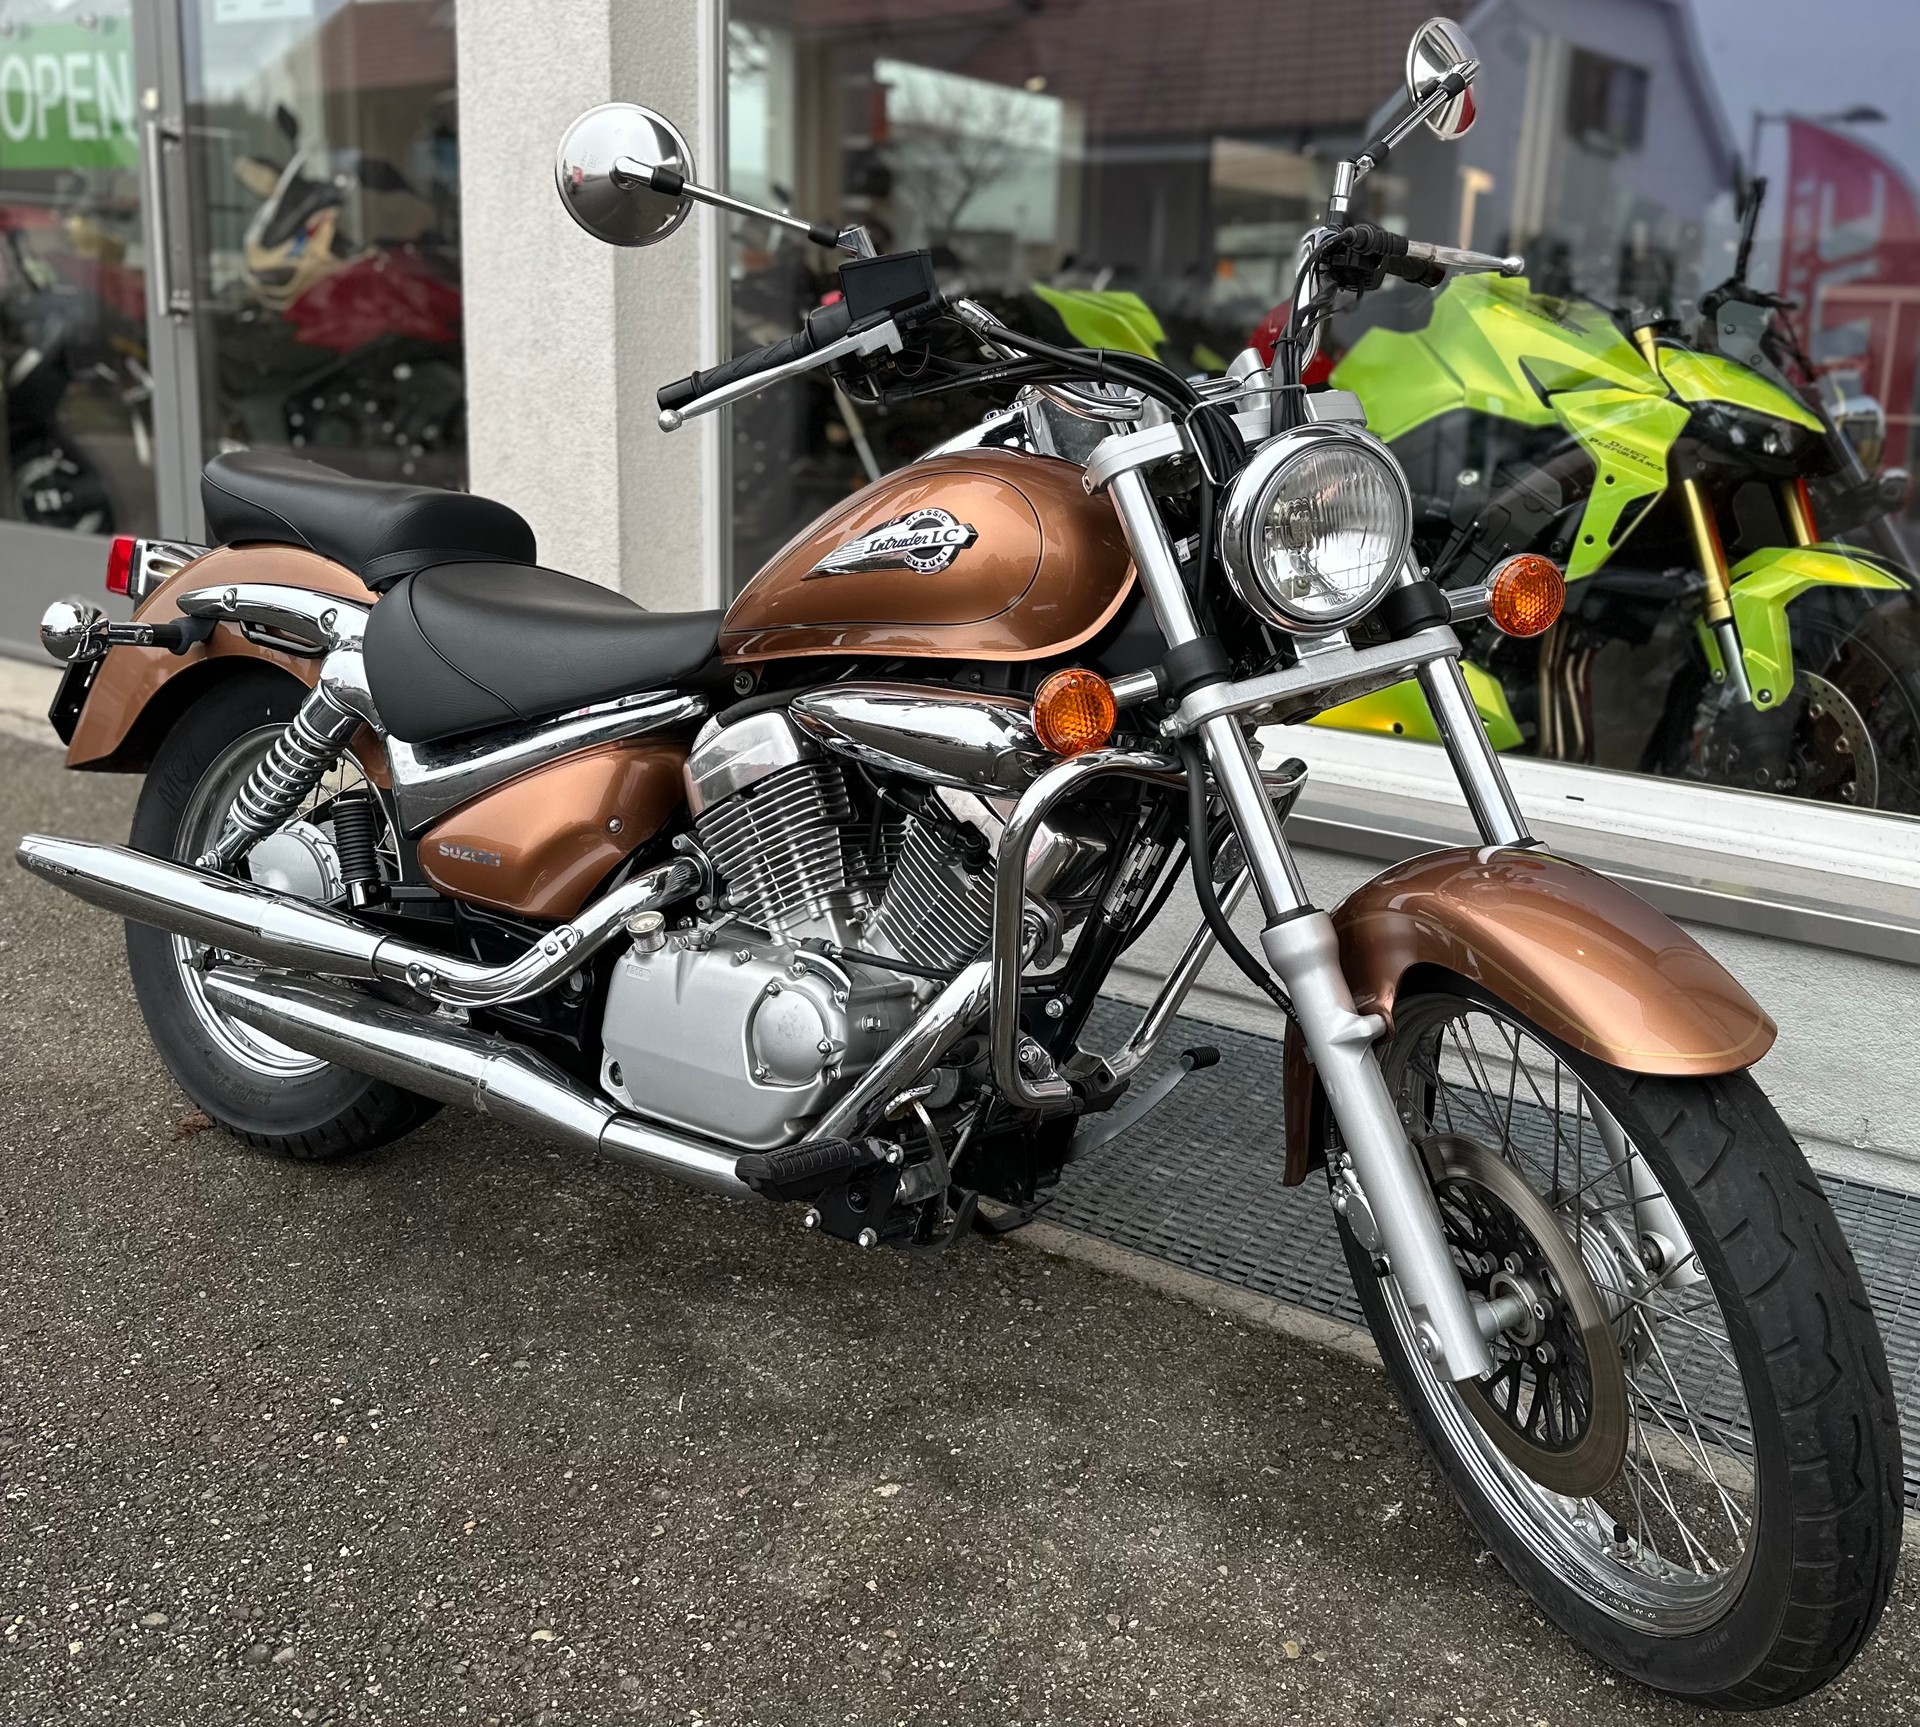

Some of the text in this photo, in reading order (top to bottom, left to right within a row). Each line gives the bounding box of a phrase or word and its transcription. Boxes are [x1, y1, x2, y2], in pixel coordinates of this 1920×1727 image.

[1, 51, 137, 142] OPEN
[1588, 437, 1664, 472] PERFORMANCE
[1609, 440, 1649, 460] DIRECT
[905, 509, 948, 526] CLASSIC
[864, 528, 959, 554] Intruder LC
[904, 551, 948, 569] SUZUKI
[439, 842, 501, 867] SUZUKI
